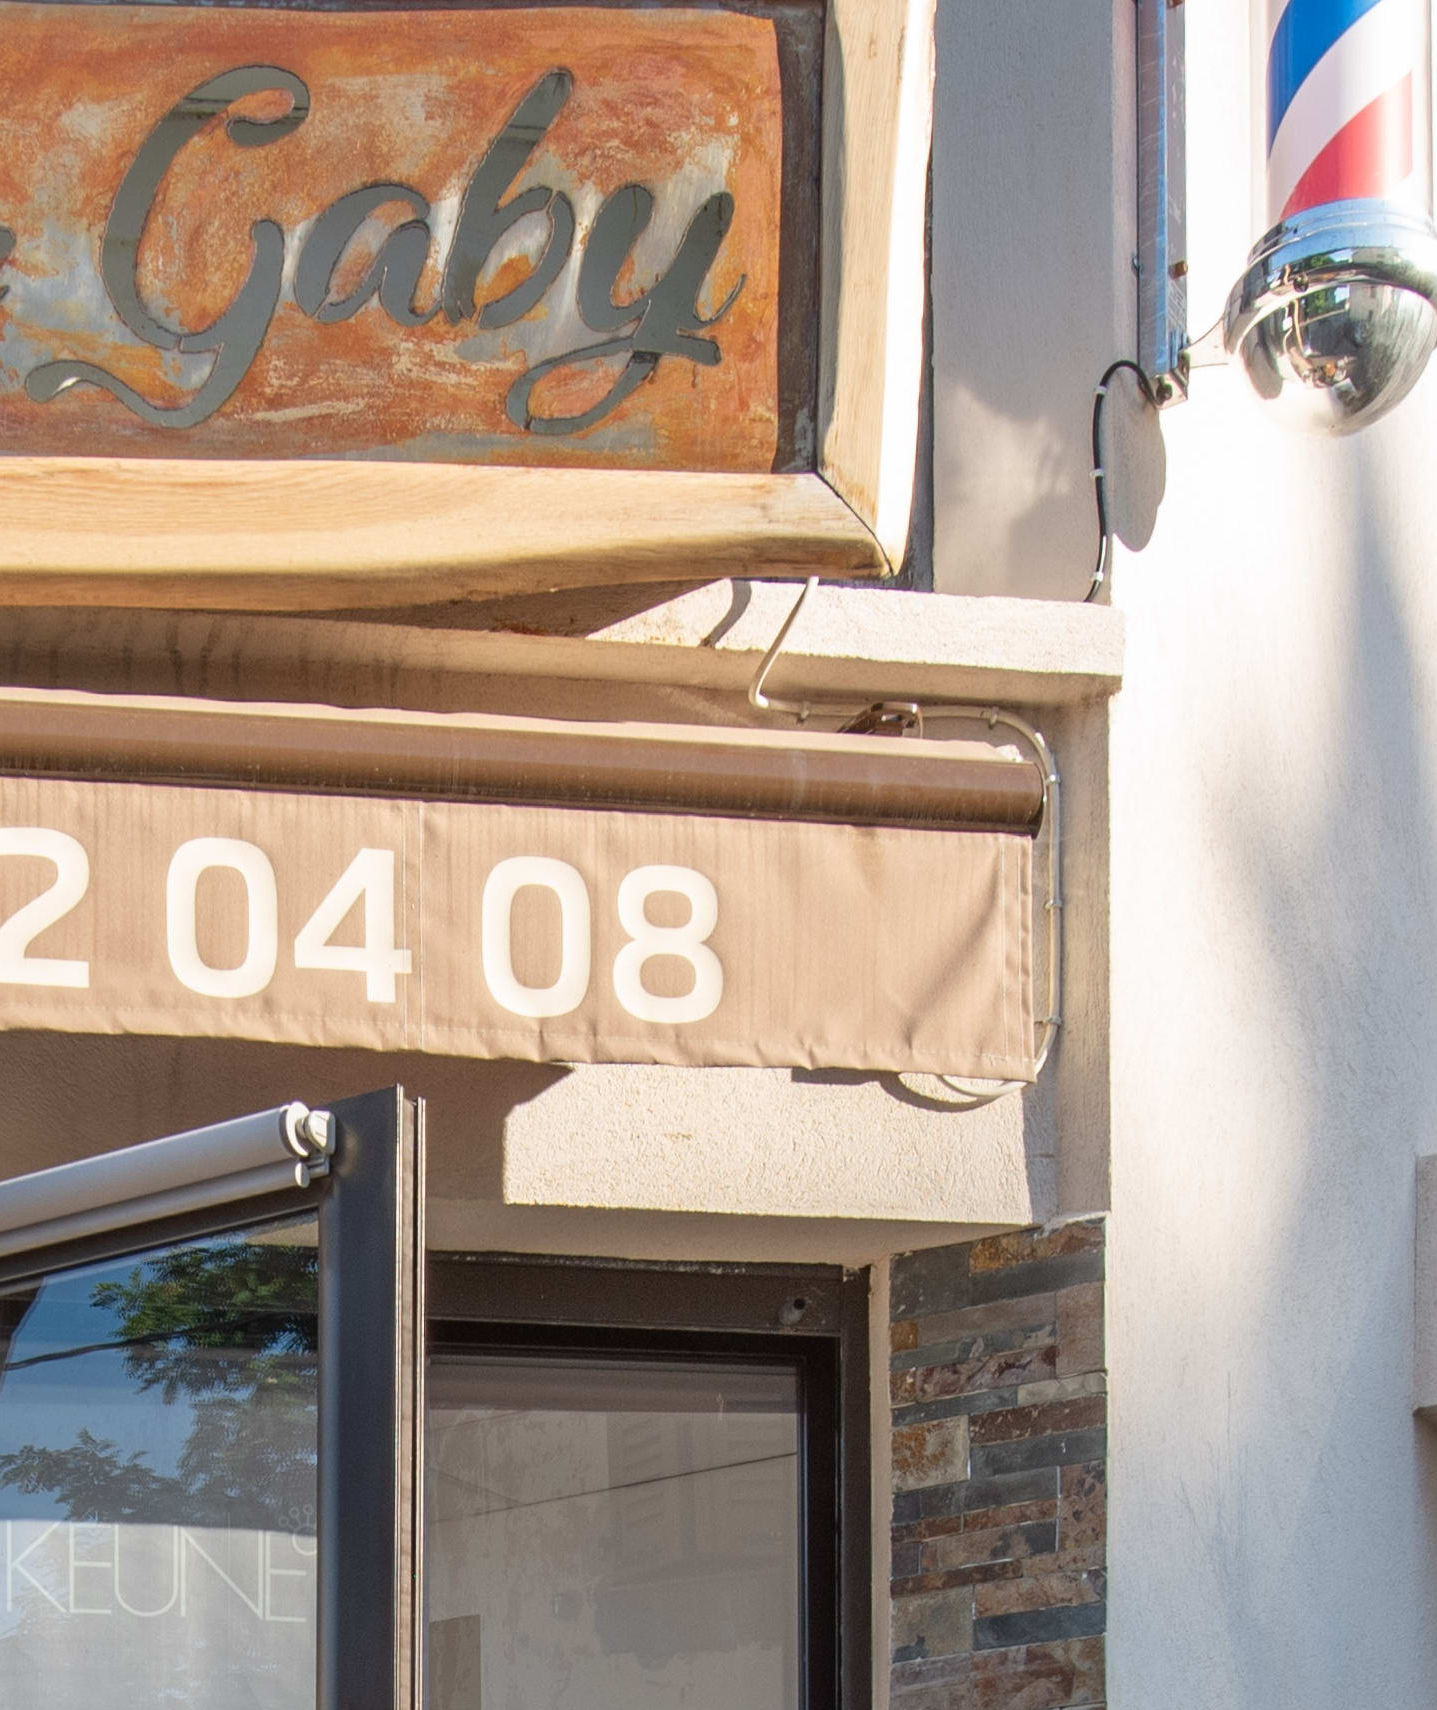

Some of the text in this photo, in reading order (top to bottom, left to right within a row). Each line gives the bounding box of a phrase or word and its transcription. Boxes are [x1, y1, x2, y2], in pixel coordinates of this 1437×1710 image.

[24, 61, 745, 437] Gaby
[164, 839, 412, 1008] 04
[479, 853, 727, 1026] 08
[7, 1520, 307, 1622] KEUNE
